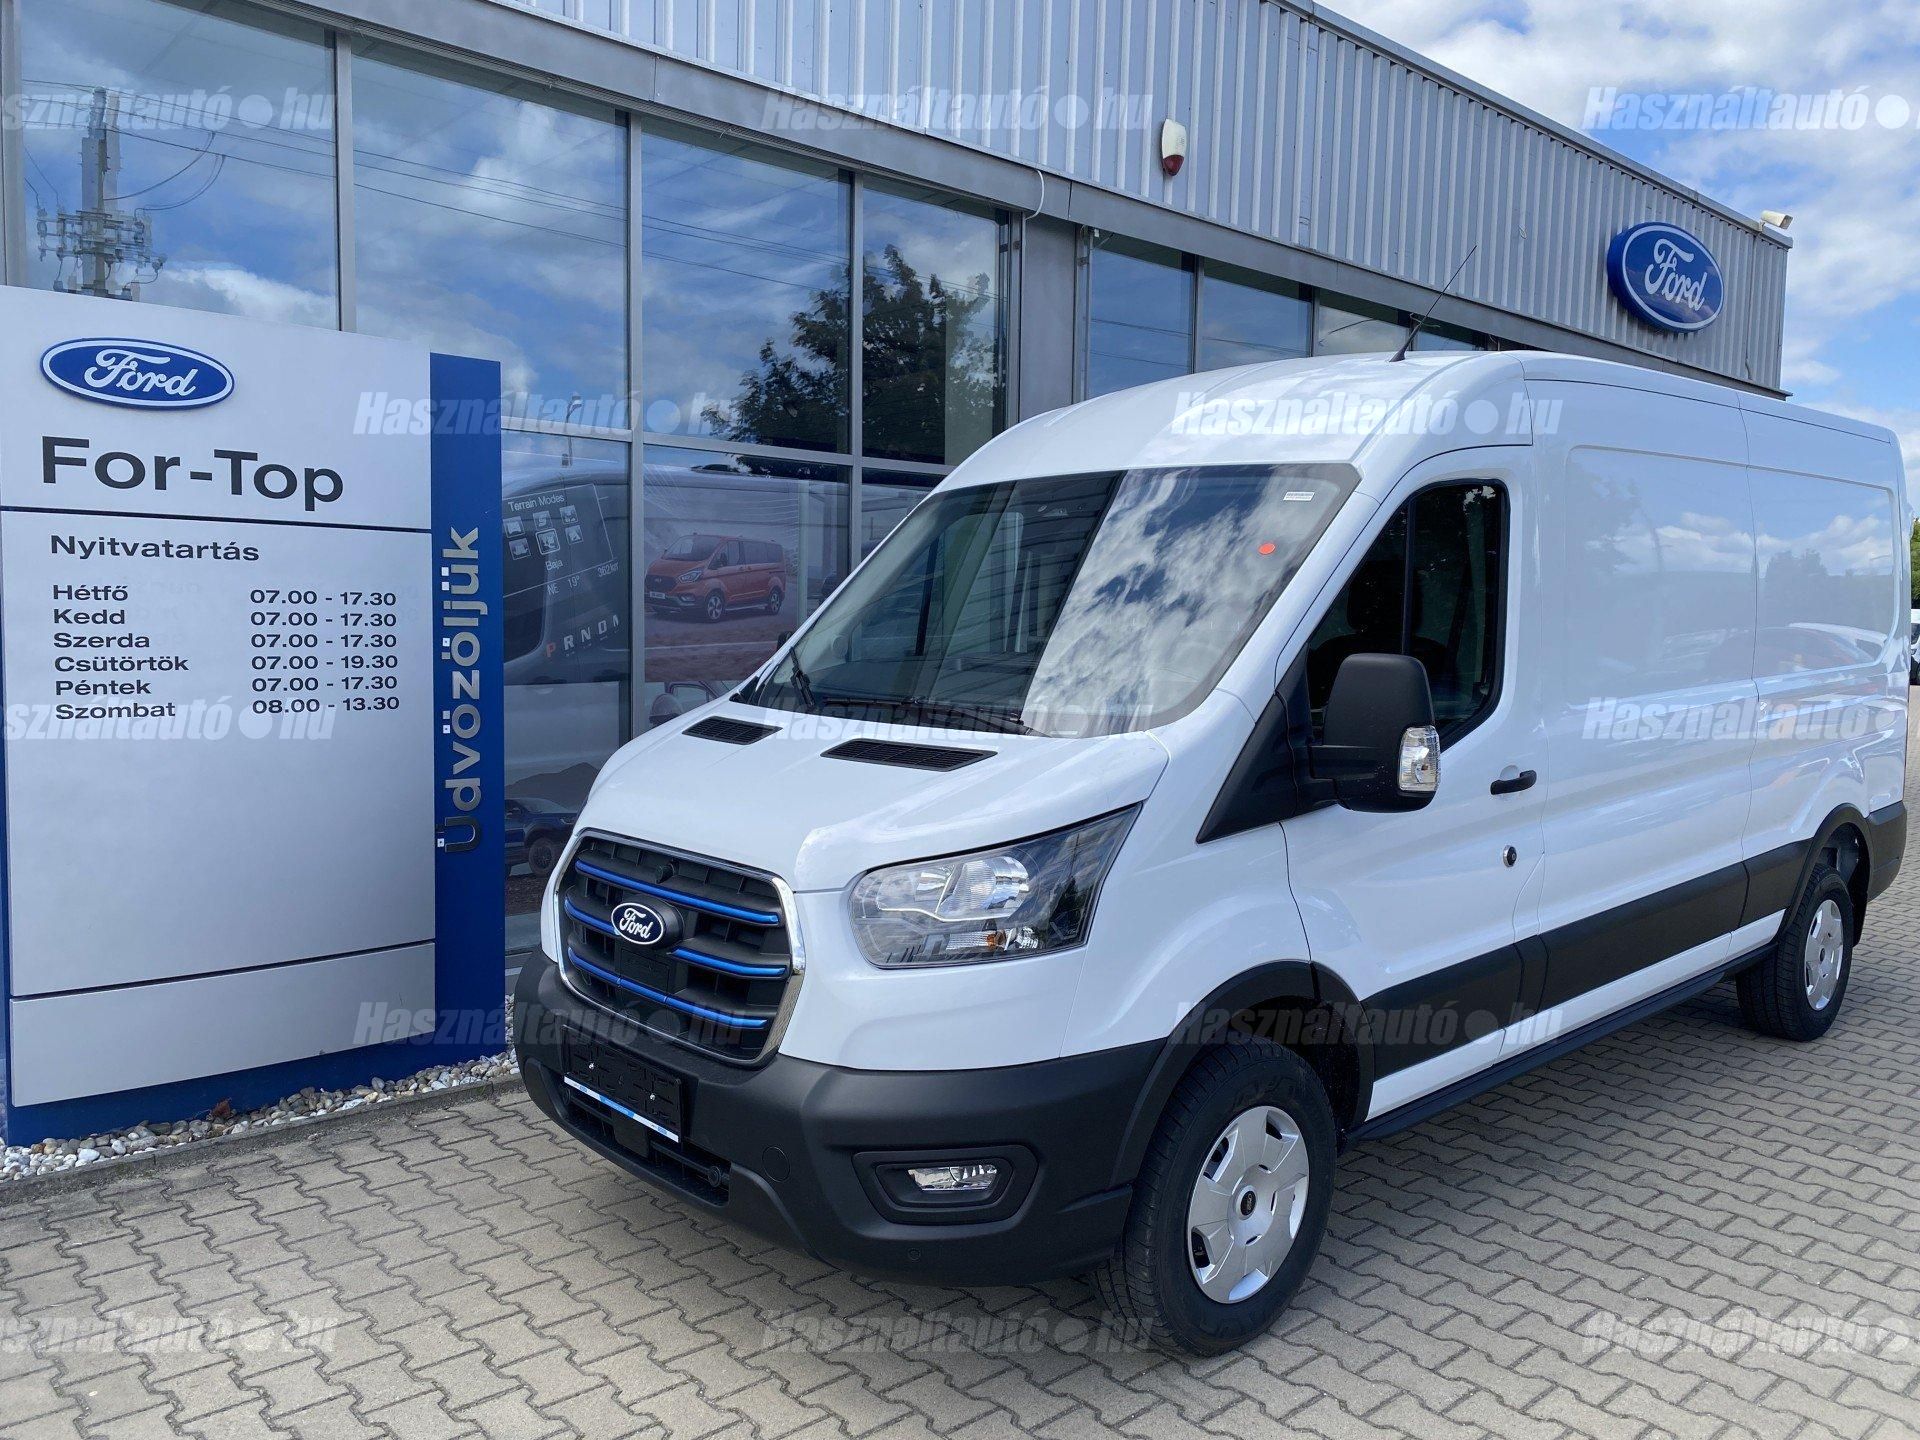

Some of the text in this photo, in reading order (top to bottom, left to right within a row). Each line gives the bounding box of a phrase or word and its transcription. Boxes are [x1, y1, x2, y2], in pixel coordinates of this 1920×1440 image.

[1644, 238, 1708, 312] Ford
[83, 347, 199, 399] Ford
[42, 436, 344, 512] For-Top
[538, 493, 565, 506] Modes
[50, 534, 260, 561] Nyitvatartás
[53, 584, 129, 602] Hétfő
[251, 590, 318, 605] 07.00
[340, 591, 397, 606] 17.30
[53, 608, 126, 625] Kedd
[251, 612, 318, 627] 07.00
[340, 613, 397, 627] 17.30
[53, 632, 151, 649] Szerda
[251, 633, 318, 648] 07.00
[340, 634, 397, 648] 17.30
[54, 655, 190, 673] Csütörtök
[252, 655, 319, 670] 07.00
[341, 655, 398, 669] 19.30
[55, 679, 152, 696] Péntek
[252, 677, 319, 692] 07.00
[341, 676, 398, 690] 17.30
[435, 526, 489, 853] Üdvözöljük
[56, 701, 176, 720] Szombat
[252, 699, 320, 714] 08.00
[343, 697, 400, 711] 13.30
[618, 907, 654, 940] Ford
